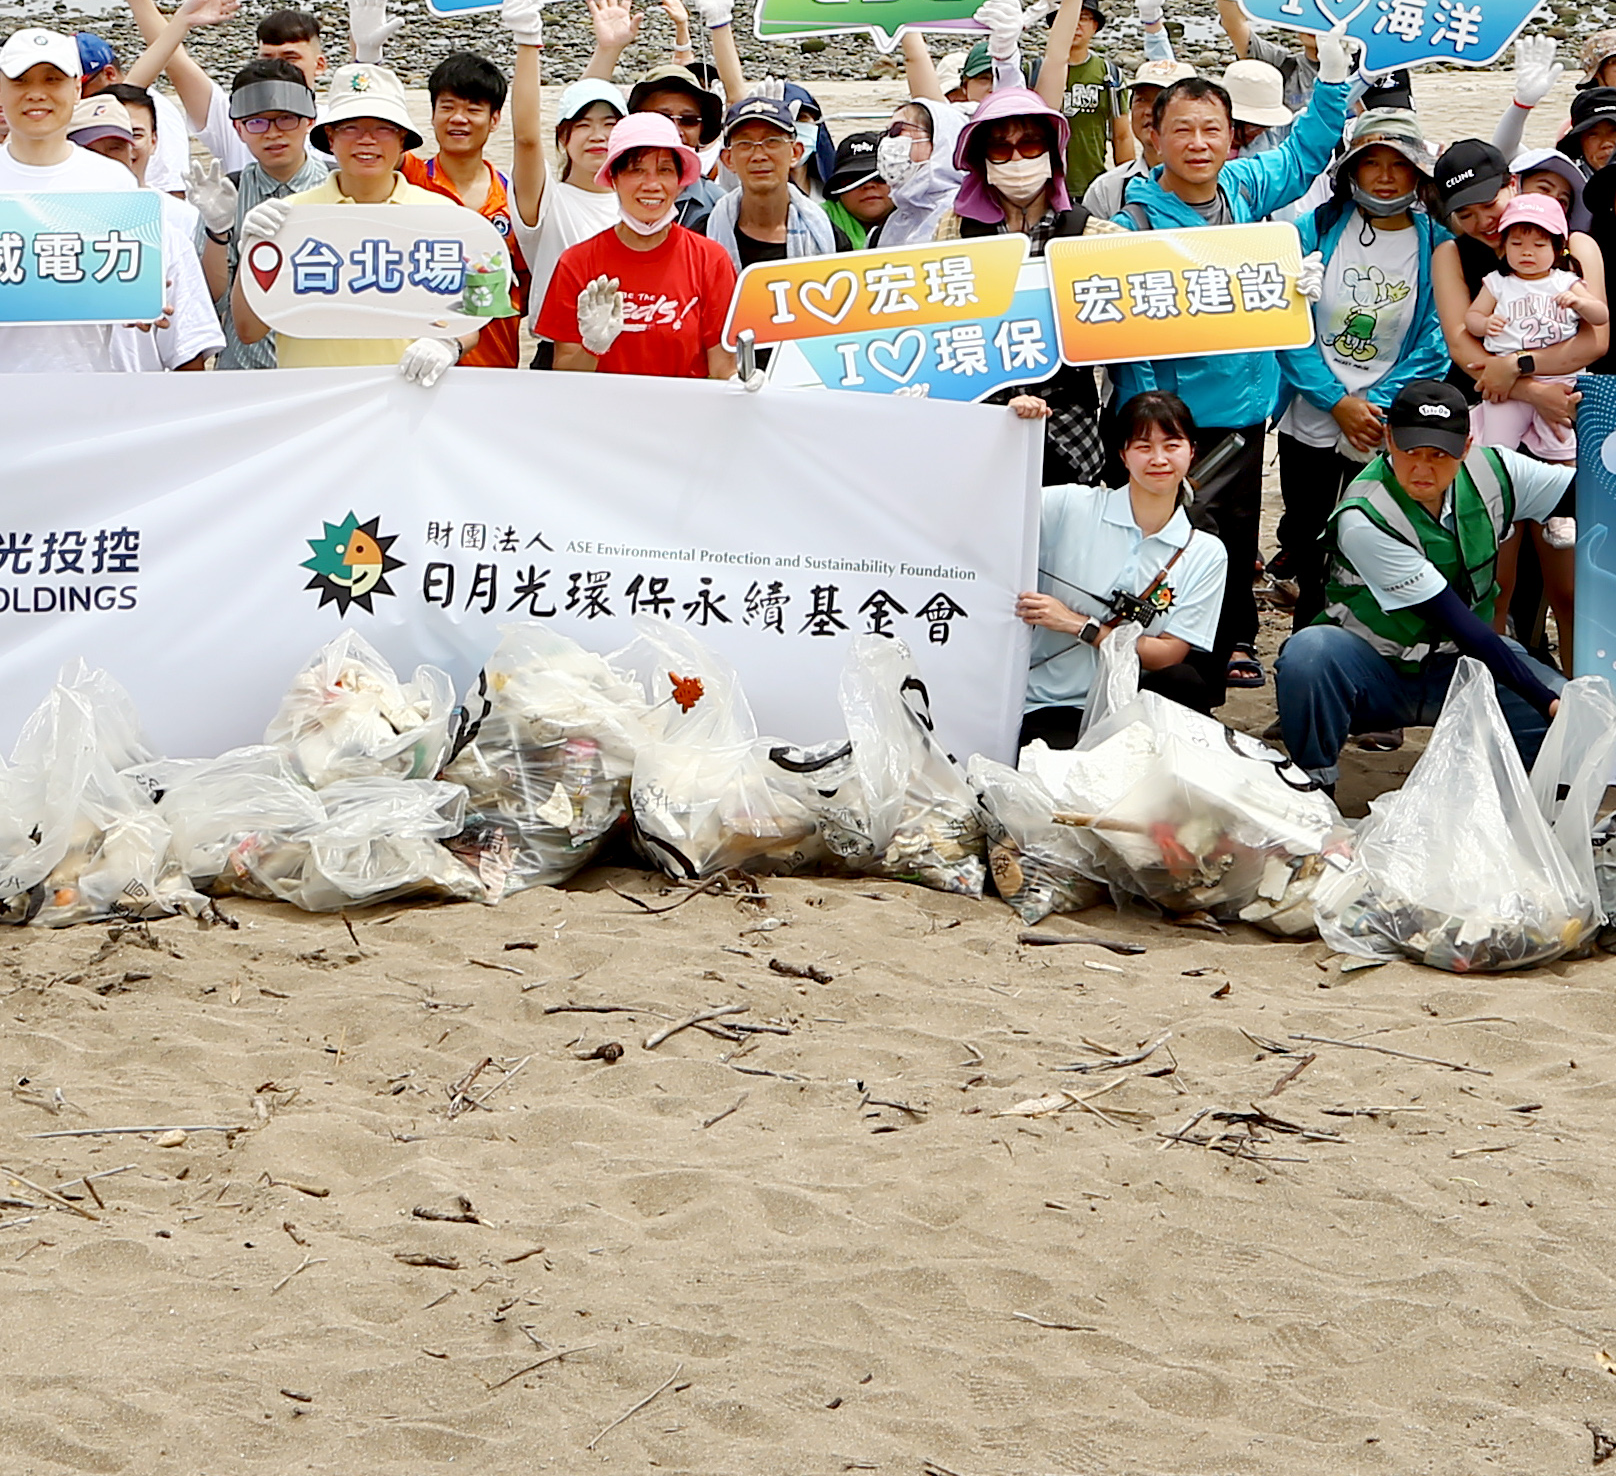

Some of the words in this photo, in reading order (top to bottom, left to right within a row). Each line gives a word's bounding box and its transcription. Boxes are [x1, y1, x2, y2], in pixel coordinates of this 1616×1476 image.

[1446, 169, 1475, 188] CELINE
[290, 238, 465, 295] 台北場
[865, 255, 979, 316] 宏璟
[1074, 262, 1289, 323] 宏璟建設
[1507, 293, 1568, 324] JORDAN
[1521, 316, 1563, 350] 23
[934, 320, 1049, 375] 環保
[425, 520, 554, 554] 財團法人
[566, 540, 593, 555] ASE
[597, 541, 696, 562] Environmental
[700, 550, 771, 566] Protection
[775, 555, 801, 569] and
[804, 555, 896, 574] Sustainability
[899, 564, 976, 580] Foundation
[422, 562, 968, 645] 日月光環保永續基金會
